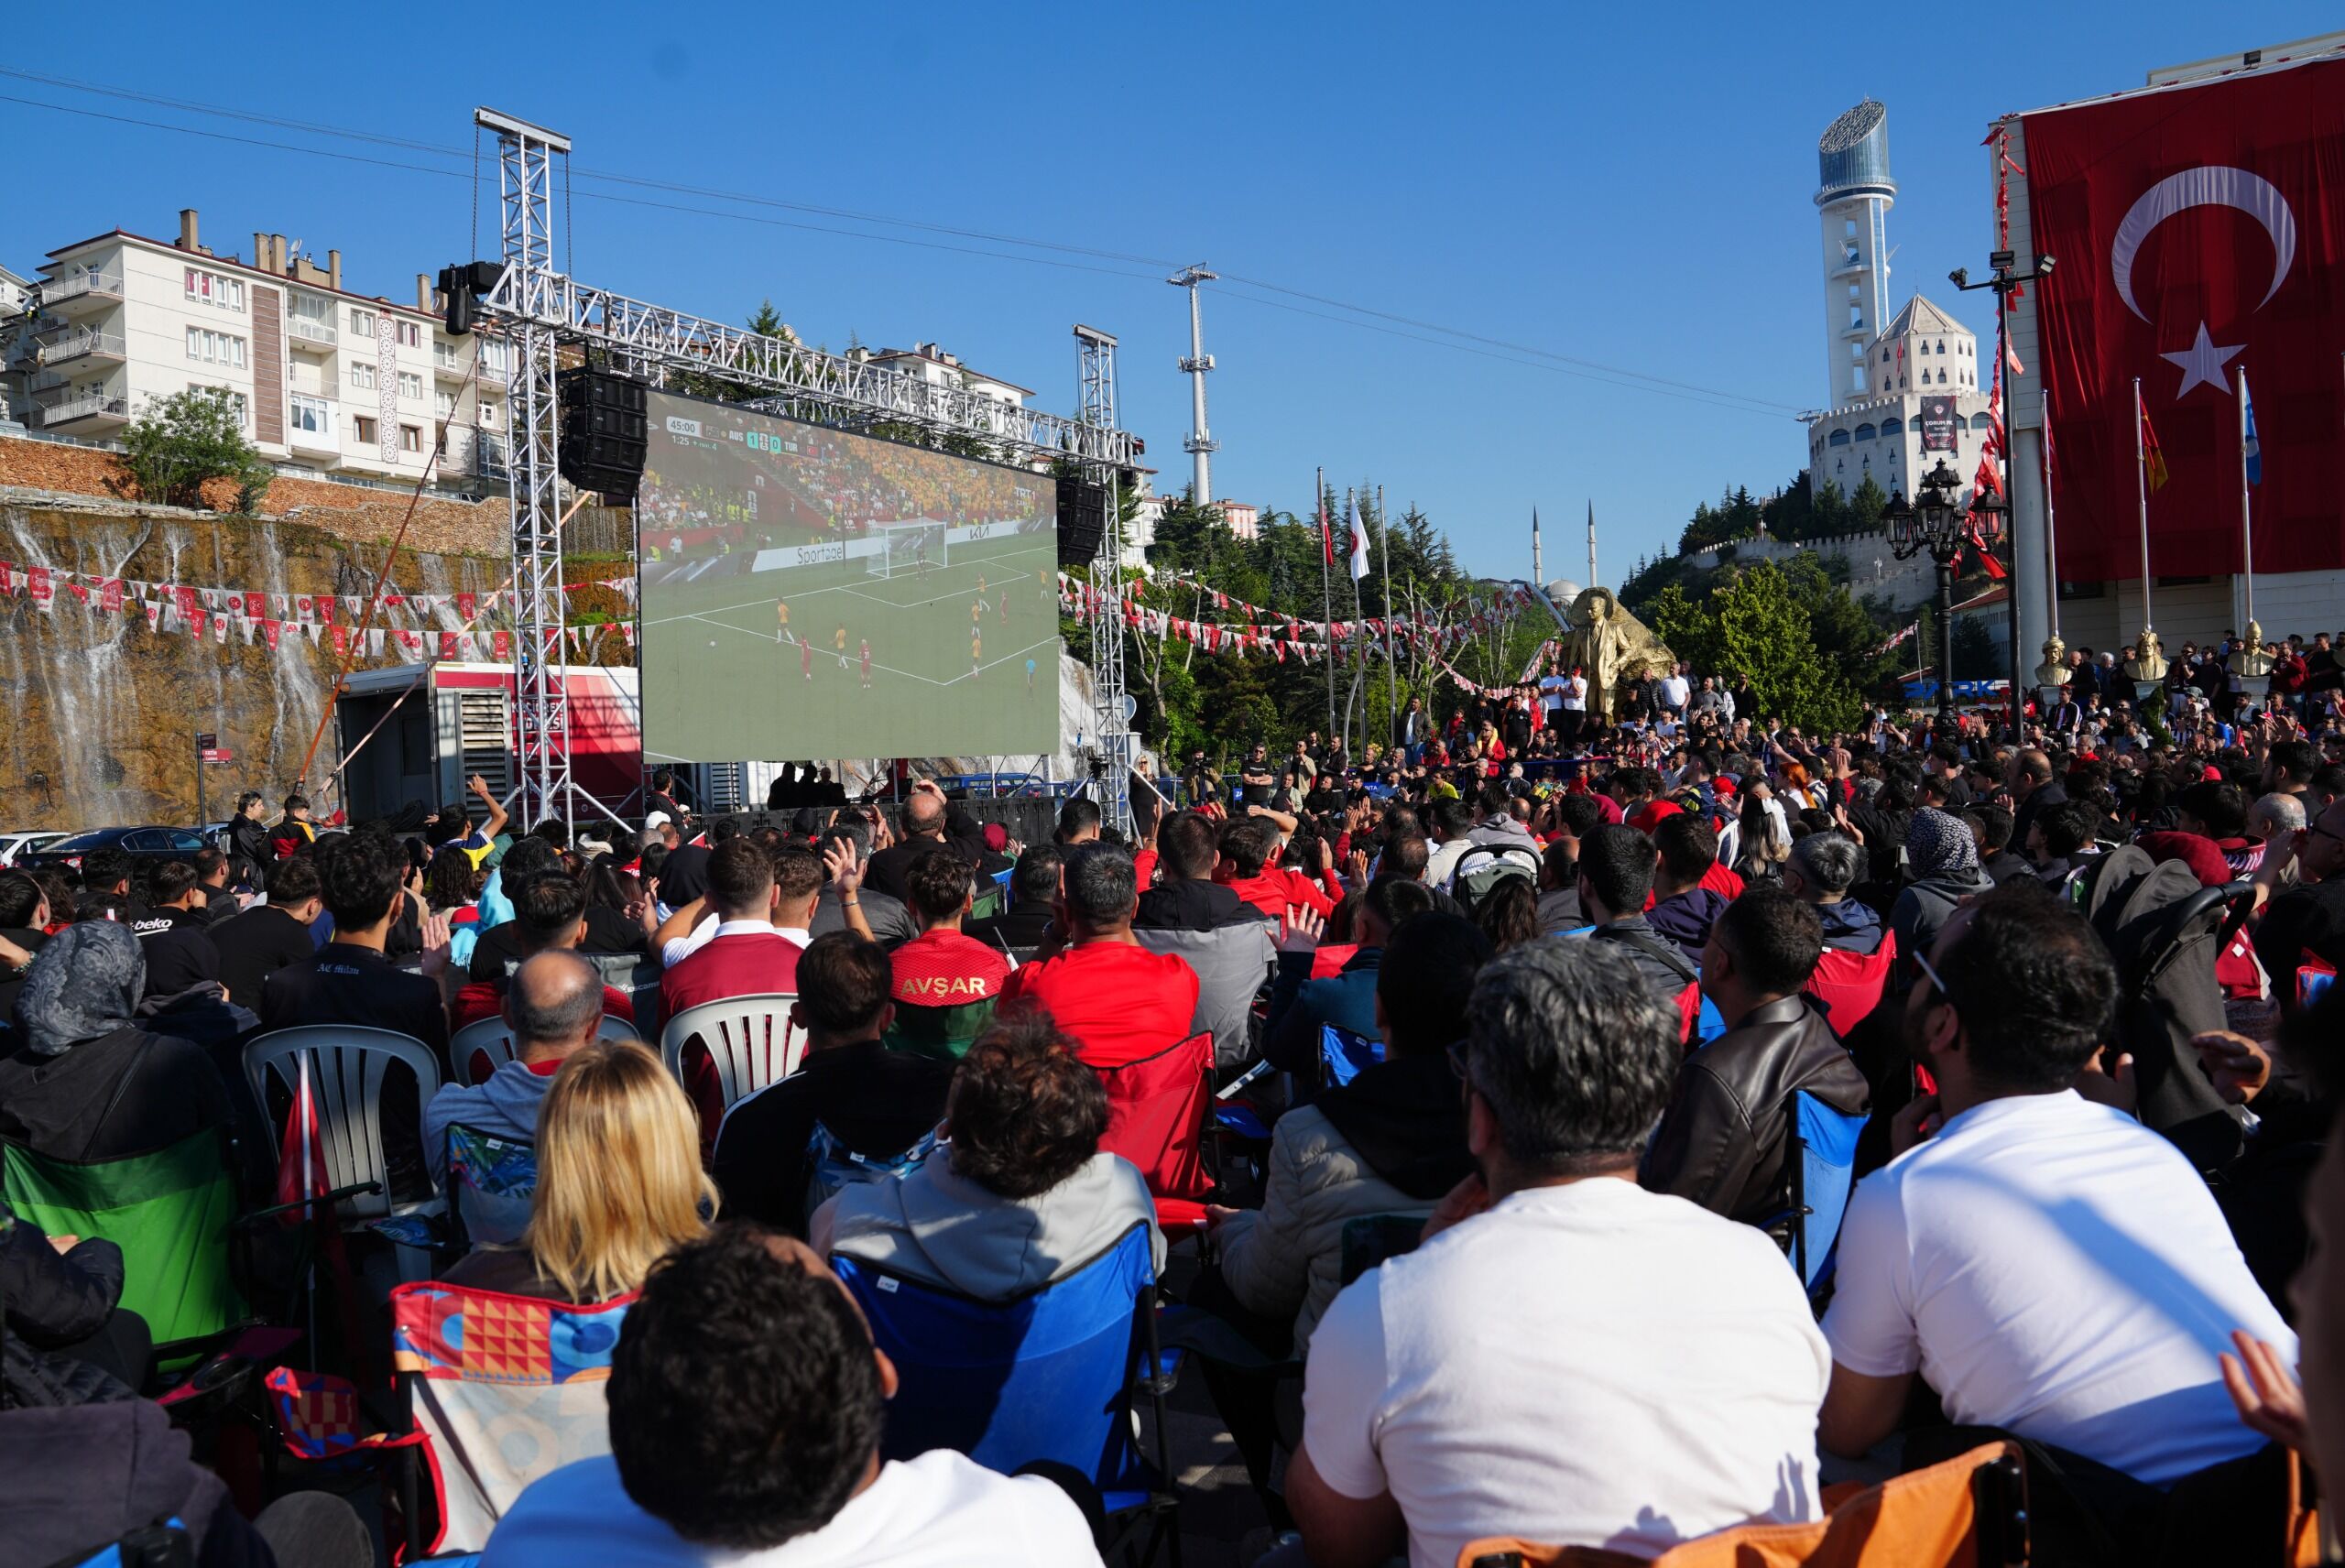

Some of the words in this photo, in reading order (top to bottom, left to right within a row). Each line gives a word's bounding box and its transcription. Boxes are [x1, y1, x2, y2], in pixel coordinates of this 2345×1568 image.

[671, 420, 695, 433] 45:00
[671, 434, 690, 446] 1:25
[728, 430, 744, 441] AUS
[784, 441, 798, 452] TUR
[1015, 486, 1031, 499] TRT
[797, 547, 843, 565] Sportage
[135, 918, 173, 931] beko
[333, 964, 360, 975] Milan
[900, 976, 987, 997] AVŞAR
